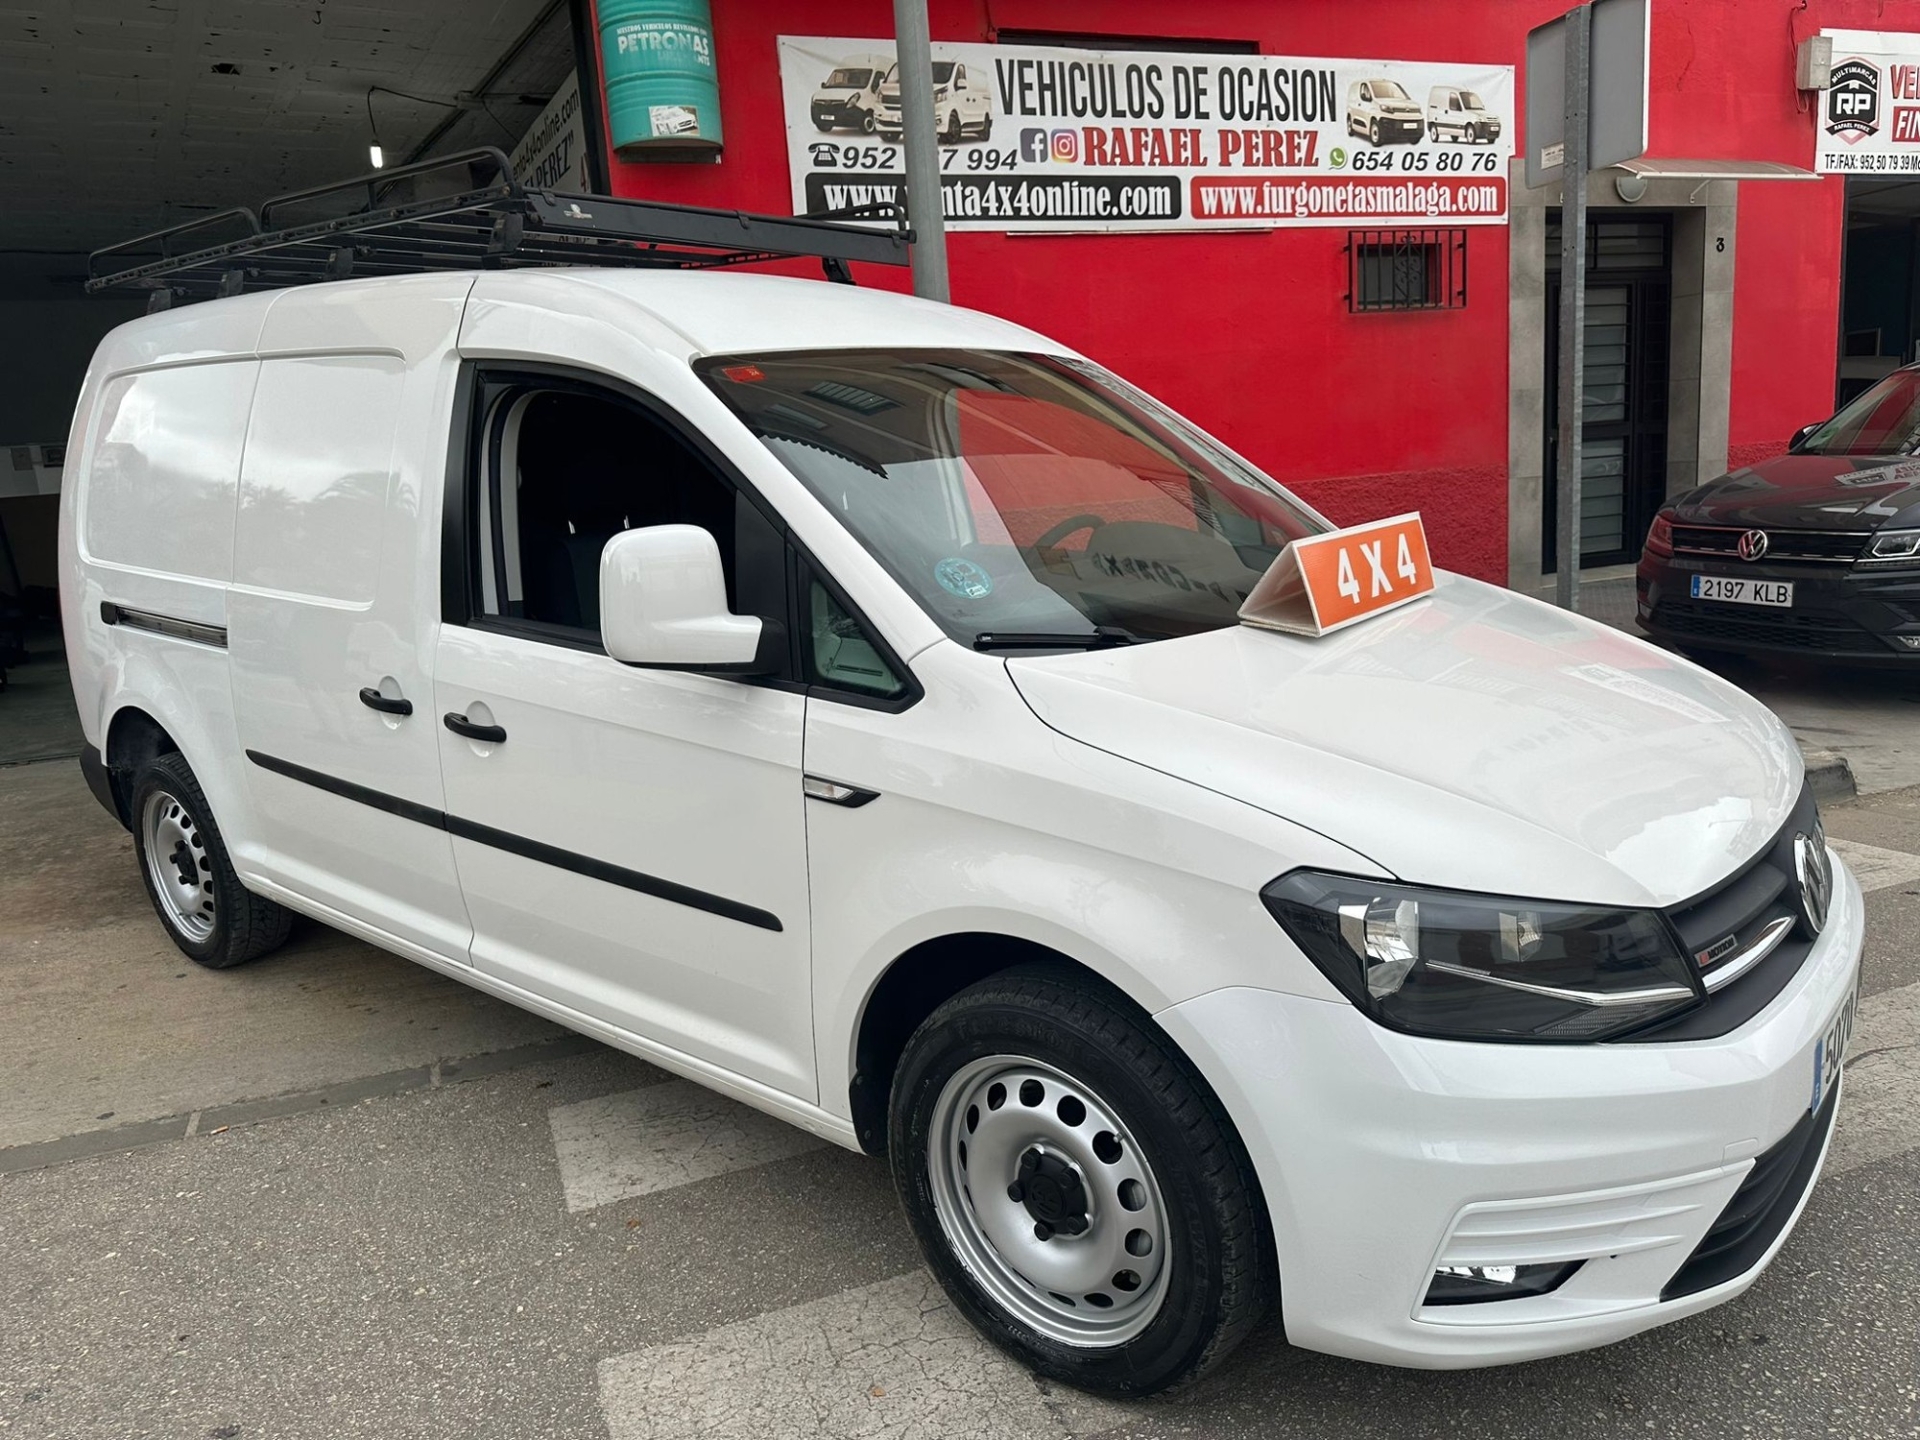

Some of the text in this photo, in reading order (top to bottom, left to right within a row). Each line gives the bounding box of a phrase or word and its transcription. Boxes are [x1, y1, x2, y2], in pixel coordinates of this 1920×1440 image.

[618, 31, 709, 56] PETRONAS
[1831, 66, 1877, 85] MULTIMARCAS
[1890, 64, 1920, 100] VE
[995, 58, 1337, 122] VEHICULOS DE OCASION
[1836, 92, 1871, 115] RP
[1834, 123, 1853, 131] RAFAEL
[842, 146, 897, 170] 952
[1082, 127, 1208, 167] RAFAEL
[1217, 129, 1320, 168] PEREZ
[967, 148, 1018, 171] 994
[1352, 151, 1498, 172] 654 05 80 76
[1860, 154, 1875, 170] 952
[1876, 155, 1887, 170] 50
[1889, 155, 1898, 170] 79
[1900, 155, 1910, 170] 39
[1200, 181, 1498, 218] www.furgonetasmalaga.com
[1716, 237, 1725, 253] 3
[1704, 579, 1788, 603] 2197 KLB
